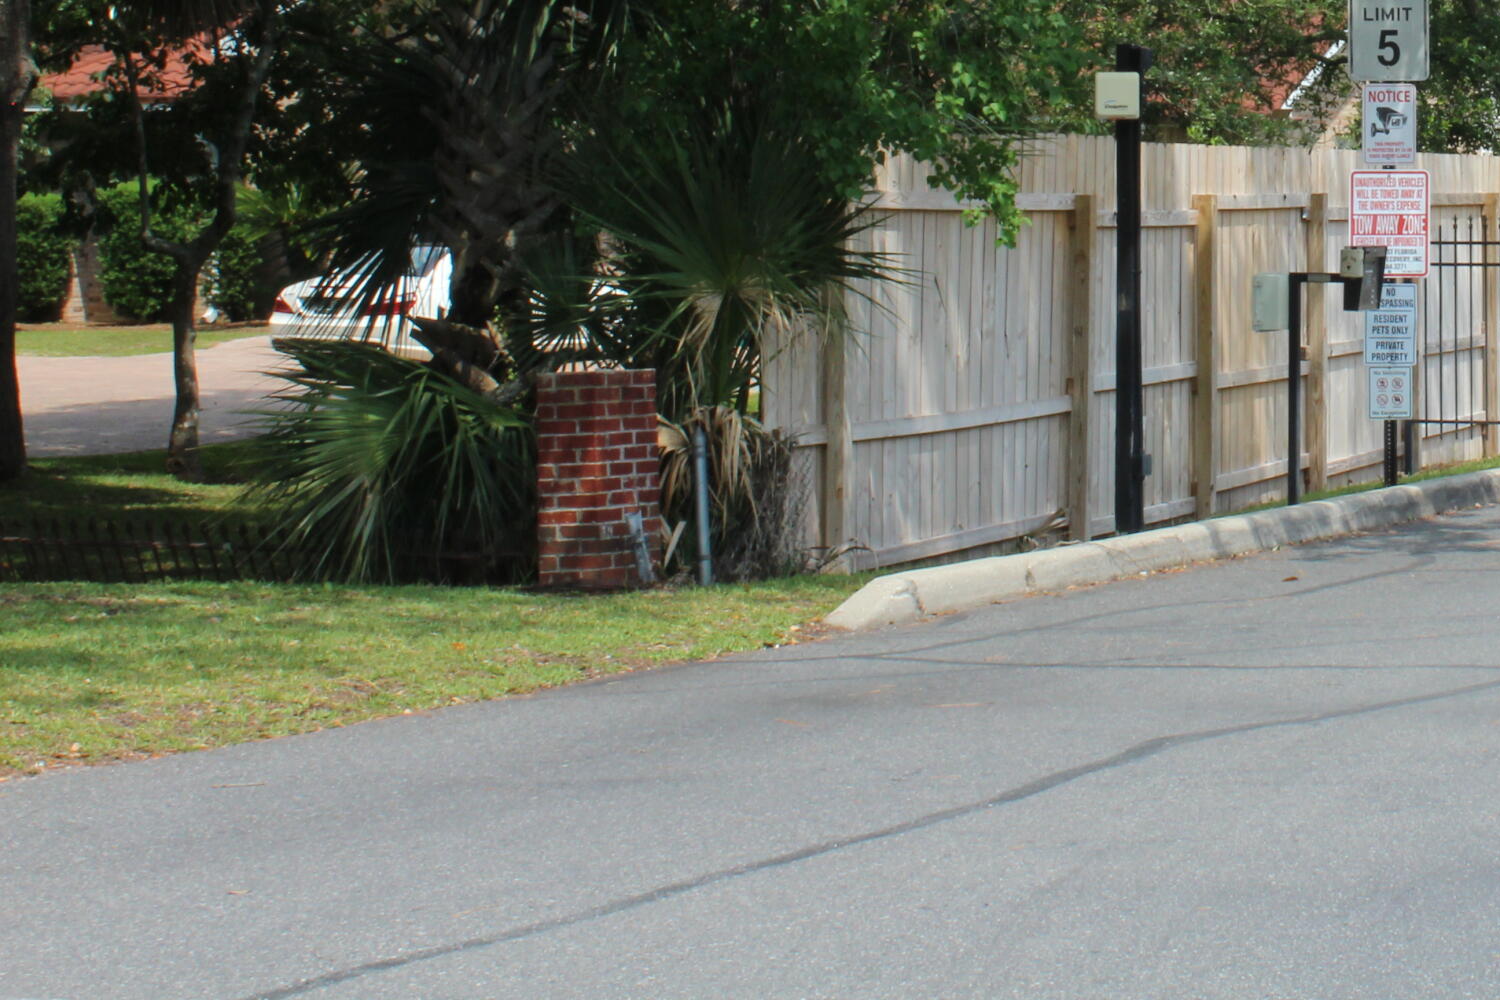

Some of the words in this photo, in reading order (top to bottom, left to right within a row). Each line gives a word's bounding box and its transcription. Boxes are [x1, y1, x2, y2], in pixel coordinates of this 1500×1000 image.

[1364, 7, 1413, 22] LIMIT
[1377, 29, 1401, 67] 5
[1368, 91, 1411, 103] NOTICE
[1355, 177, 1397, 187] UNAUTHORIZED
[1398, 177, 1424, 187] VEHICLES
[1357, 189, 1370, 198] WILL
[1371, 189, 1379, 198] BE
[1380, 189, 1399, 198] TOWED
[1401, 189, 1415, 198] AWAY
[1416, 189, 1423, 198] AT
[1358, 200, 1369, 210] THE
[1370, 200, 1395, 210] OWNER'S
[1396, 200, 1421, 210] EXPENSE
[1353, 215, 1374, 235] TOW
[1376, 215, 1400, 235] AWAY
[1402, 215, 1426, 235] ZONE
[1386, 288, 1396, 297] NO
[1381, 299, 1414, 308] SPASSING
[1373, 314, 1408, 324] RESIDENT
[1372, 326, 1389, 335] PETS
[1391, 326, 1408, 335] ONLY
[1376, 341, 1404, 350] PRIVATE
[1371, 352, 1409, 362] PROPERTY
